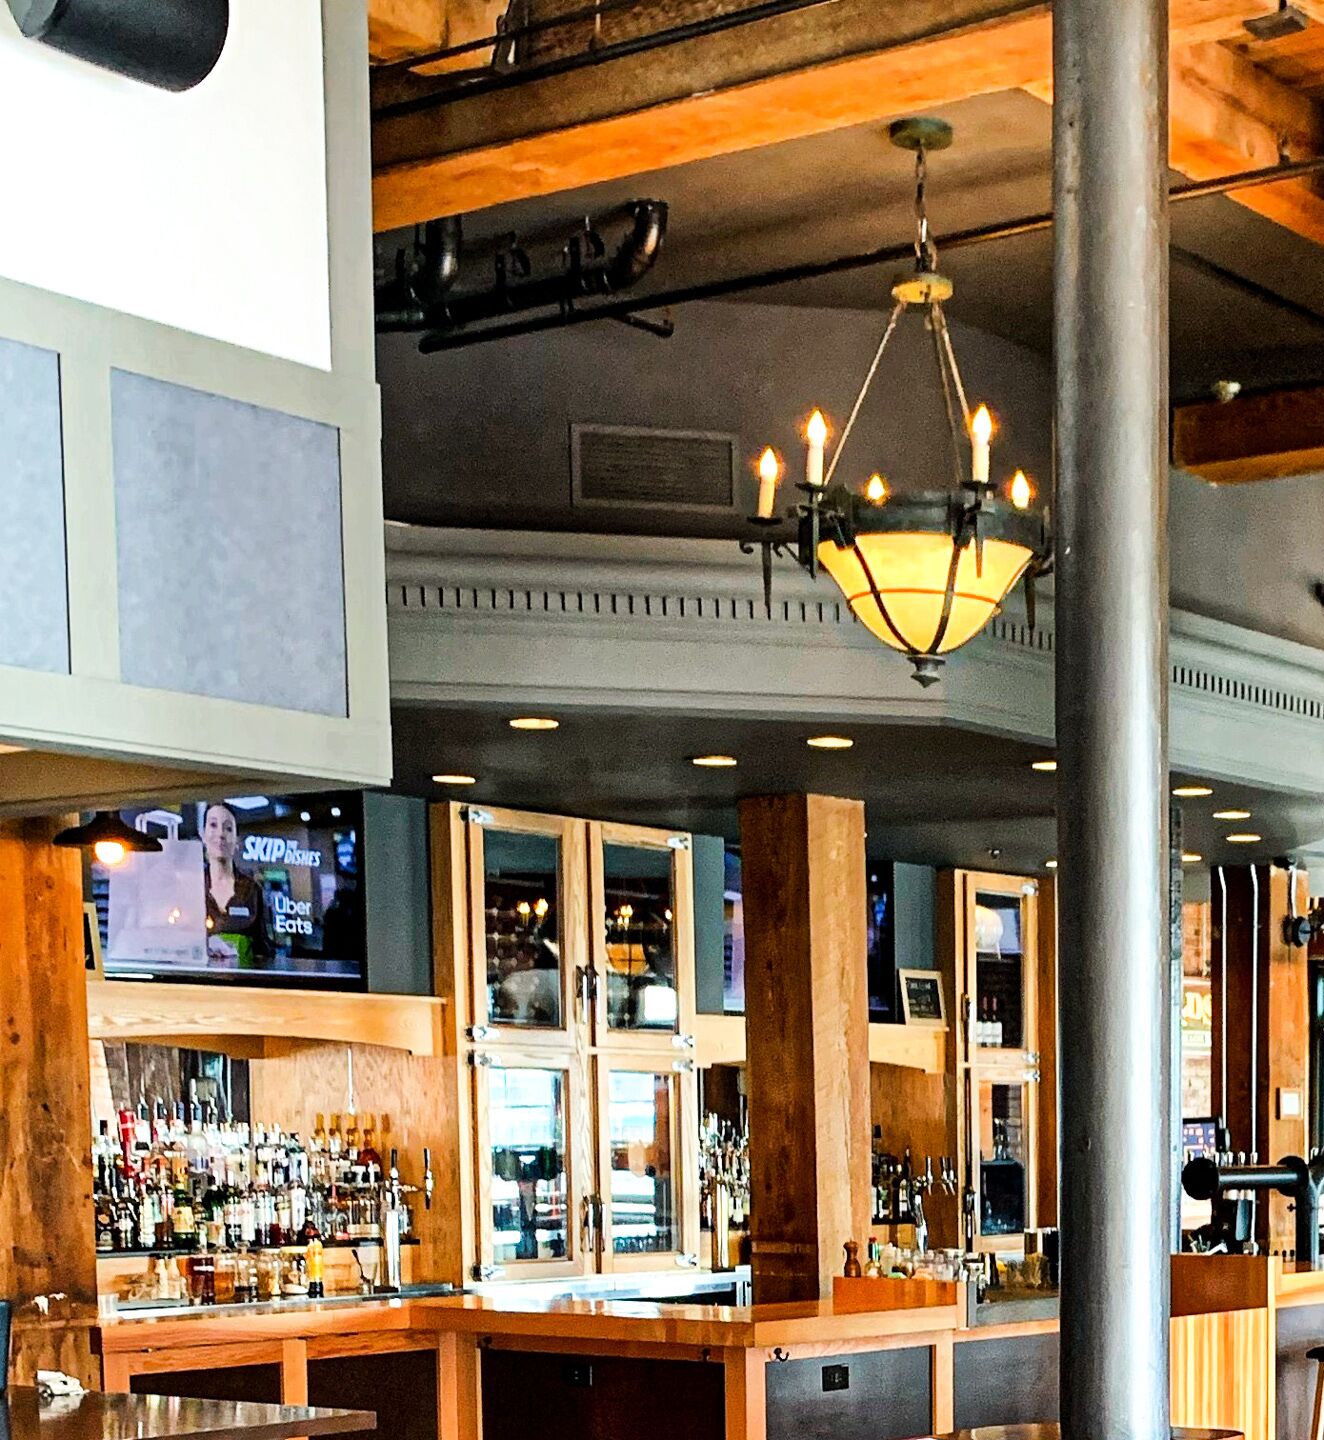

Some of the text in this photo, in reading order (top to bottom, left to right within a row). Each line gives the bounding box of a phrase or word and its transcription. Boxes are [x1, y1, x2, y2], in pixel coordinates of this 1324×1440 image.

[243, 835, 286, 862] SKIP
[274, 895, 312, 916] Uber
[275, 914, 313, 935] Eats
